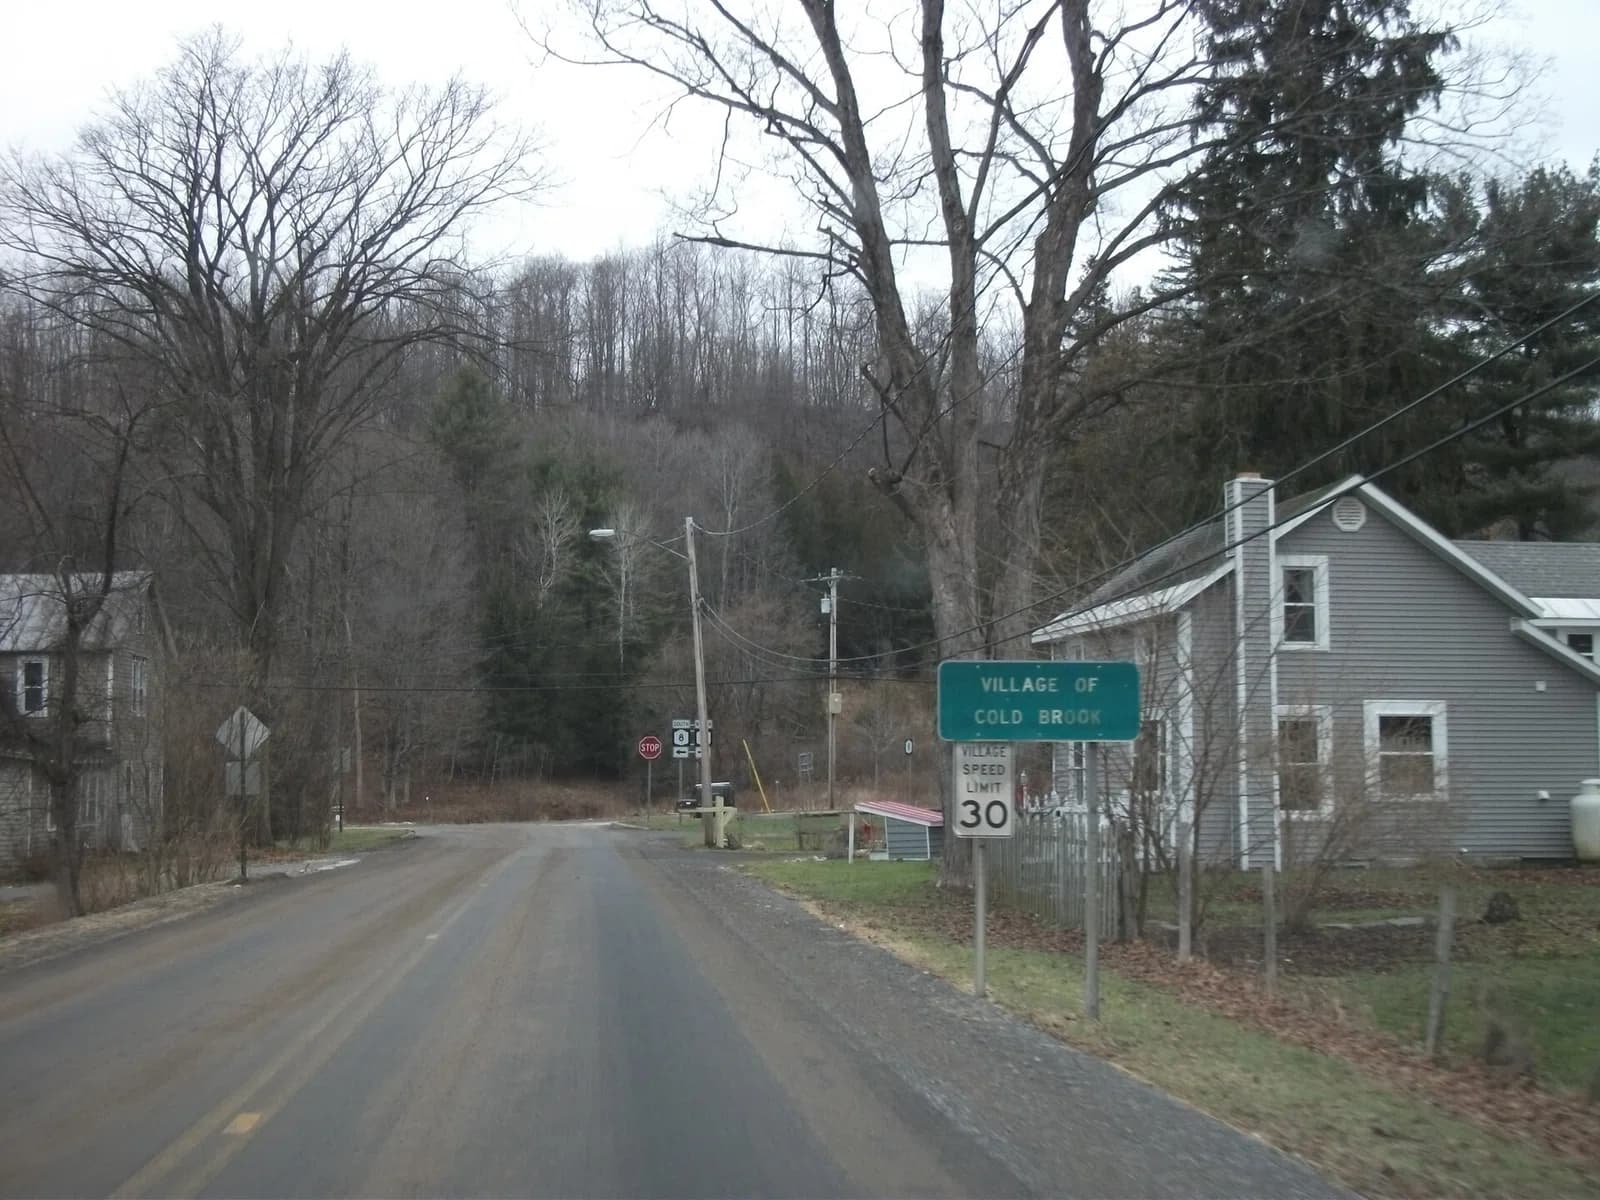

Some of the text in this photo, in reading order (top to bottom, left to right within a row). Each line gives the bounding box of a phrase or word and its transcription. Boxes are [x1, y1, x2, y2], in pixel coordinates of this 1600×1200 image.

[981, 677, 1099, 692] VILLAGE OF
[974, 709, 1102, 724] COLD BROOK
[641, 743, 660, 752] STOP
[962, 745, 1007, 758] VILLAGE
[962, 763, 1006, 776] SPEED
[966, 782, 1001, 793] LIMIT
[960, 799, 1008, 829] 30
